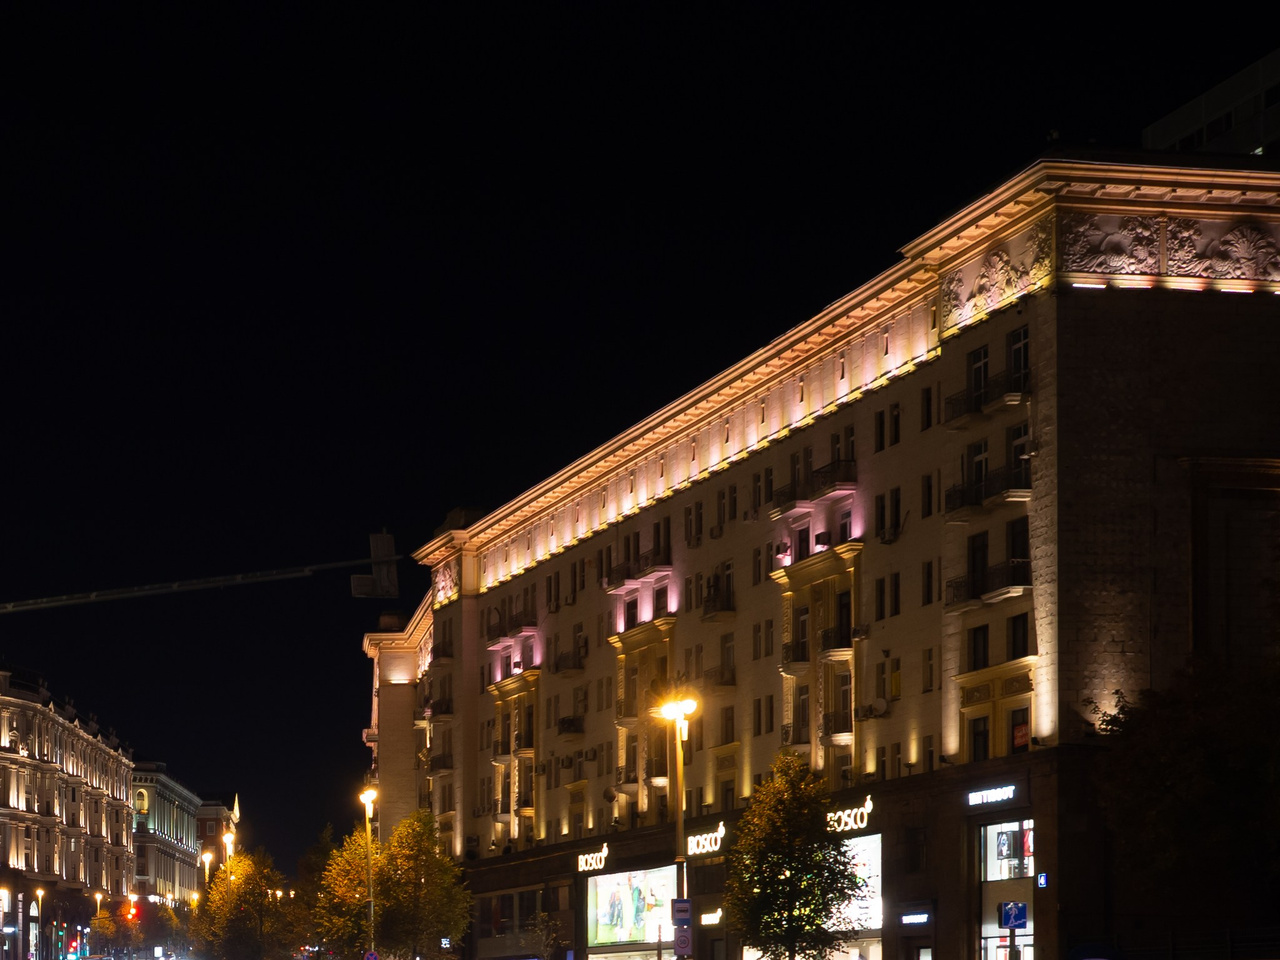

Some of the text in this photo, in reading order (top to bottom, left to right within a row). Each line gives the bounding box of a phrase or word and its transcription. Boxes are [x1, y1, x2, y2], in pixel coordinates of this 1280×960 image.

[826, 806, 868, 832] BOSCO
[687, 831, 721, 856] BOSCO
[578, 851, 605, 872] BOSCO
